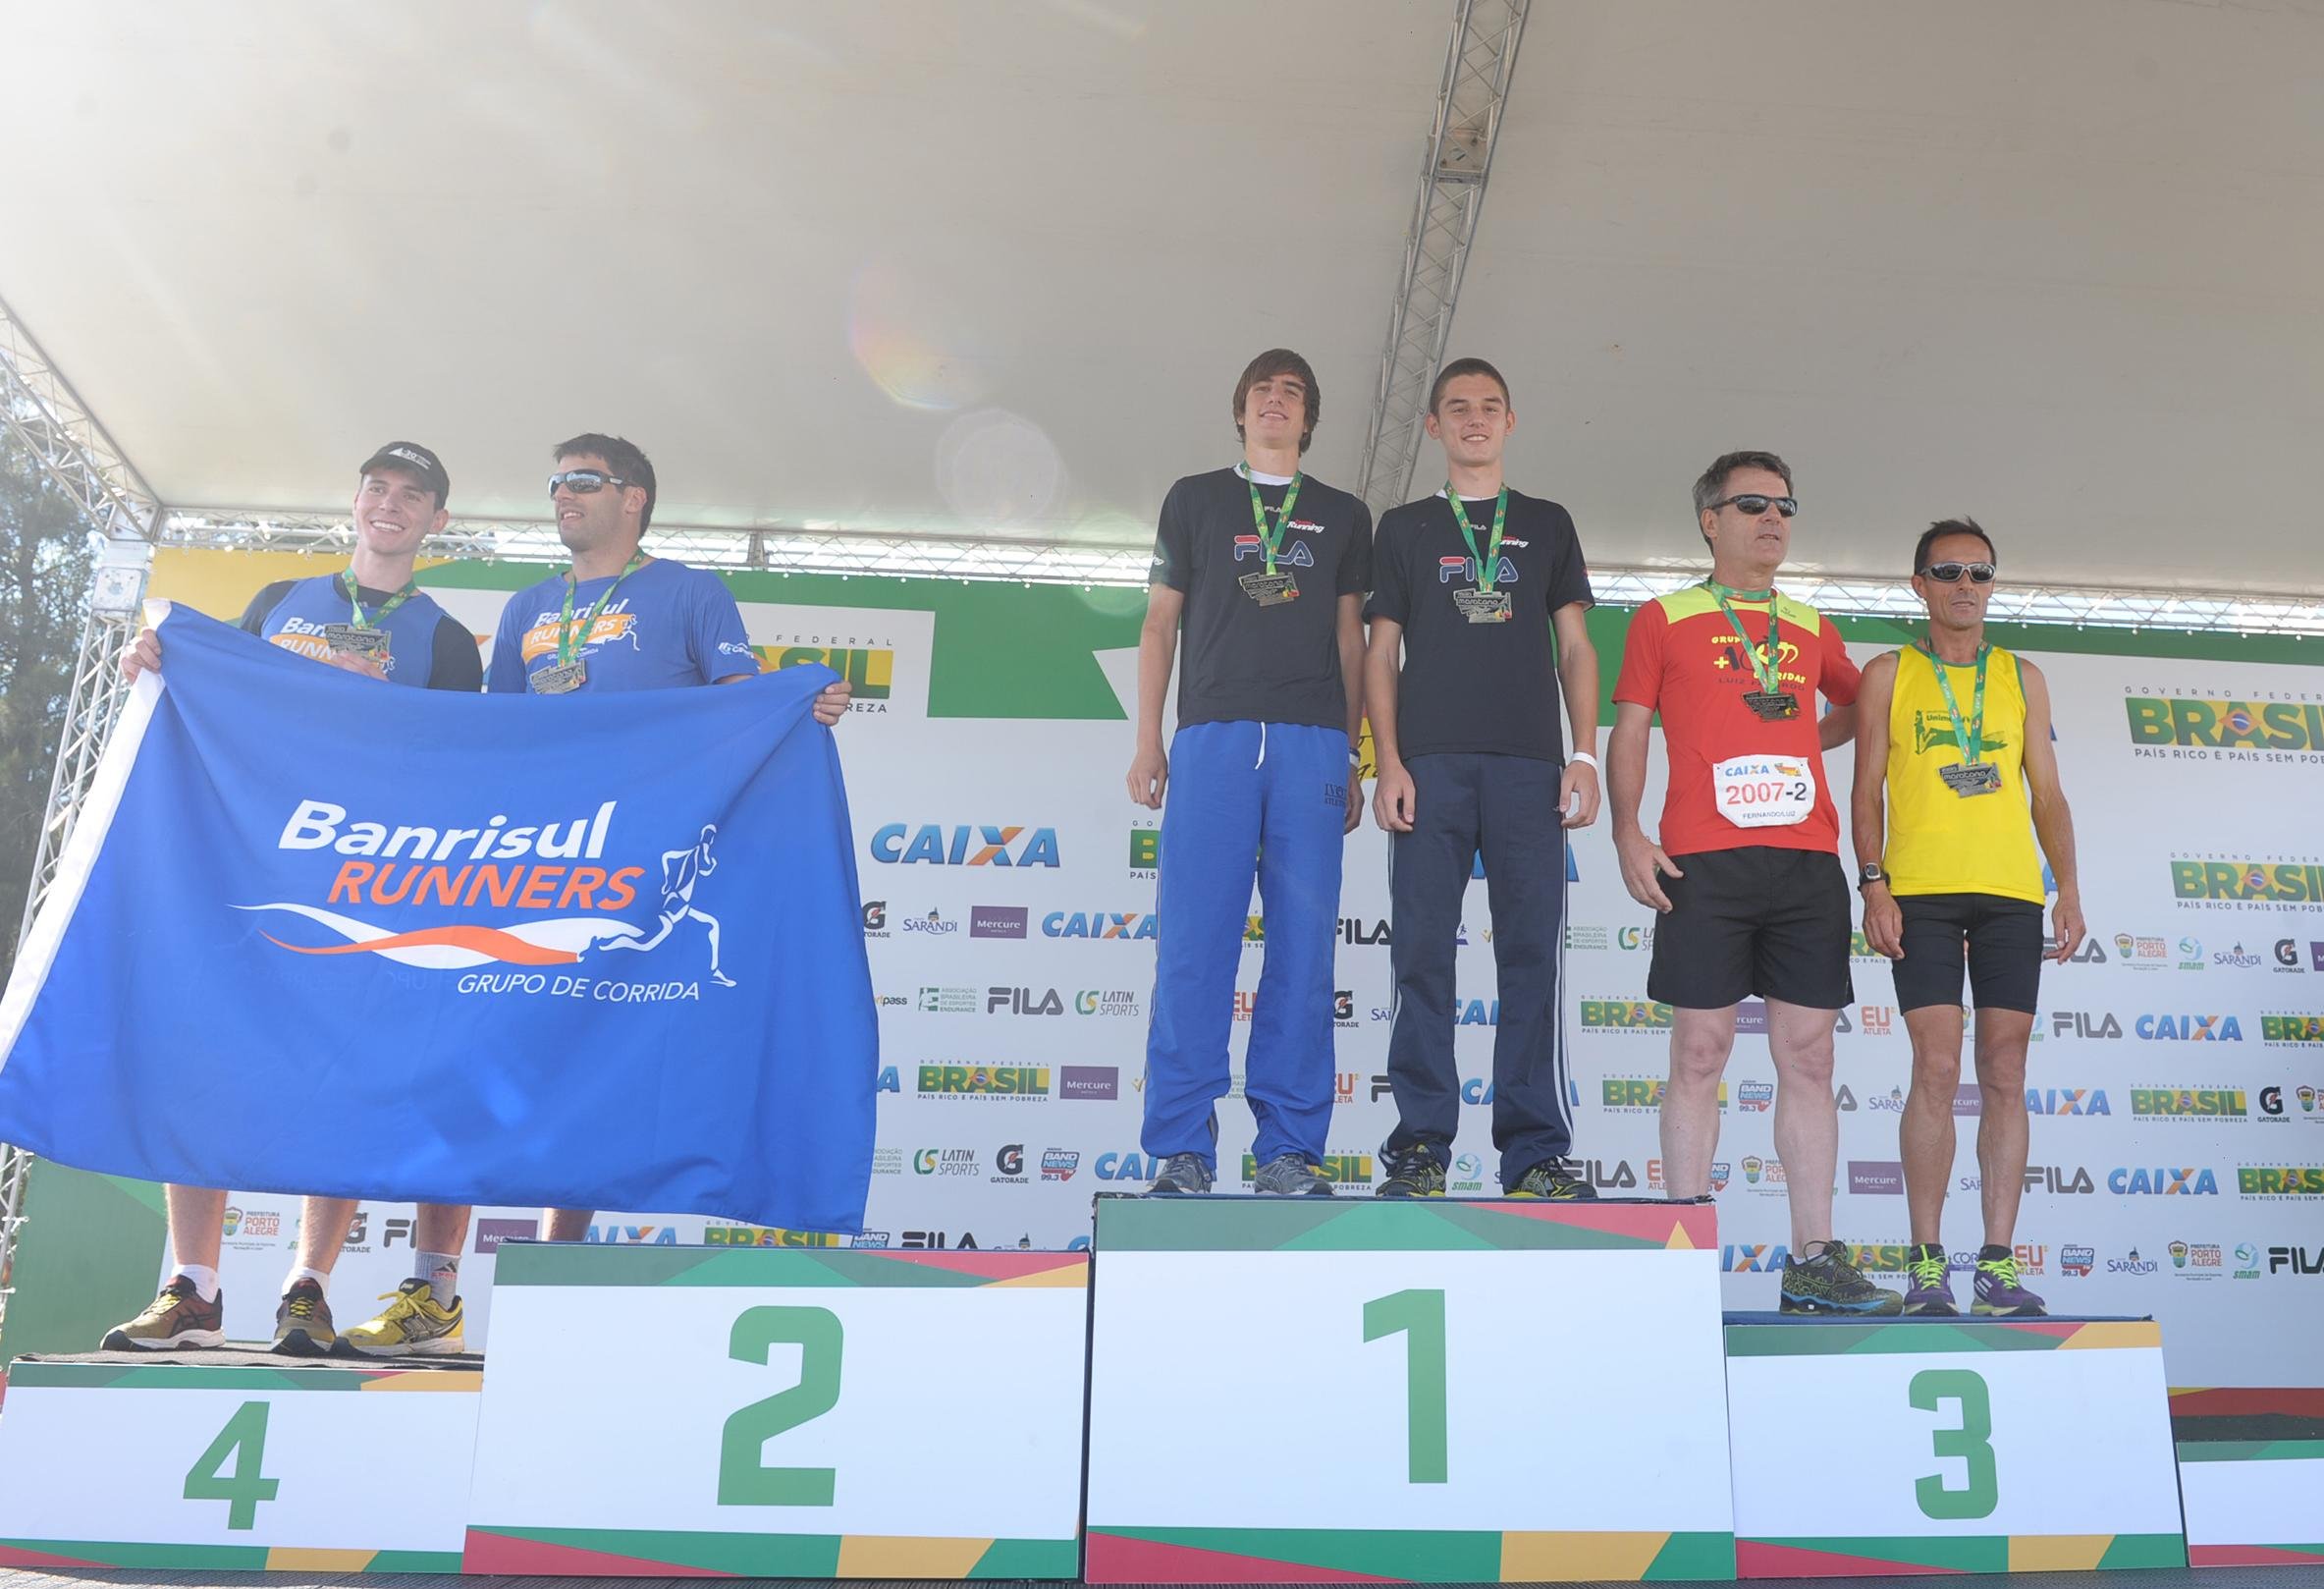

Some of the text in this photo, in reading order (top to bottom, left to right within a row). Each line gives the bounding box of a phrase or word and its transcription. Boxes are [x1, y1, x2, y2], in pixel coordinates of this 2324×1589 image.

[1286, 520, 1325, 533] Running
[533, 598, 629, 629] Bariul
[776, 634, 892, 646] FEDERAL
[2125, 685, 2322, 700] GOVERNO FEDER
[846, 703, 888, 713] REZA
[2126, 697, 2324, 751] BRASI
[2135, 748, 2166, 758] PAÍS
[2173, 749, 2207, 760] RICO
[2229, 751, 2260, 762] PAÍS
[2266, 753, 2294, 763] SEM
[1725, 764, 1769, 777] CAIXA
[1726, 782, 1807, 804] 2007-2
[278, 799, 618, 861] Banrisul
[870, 823, 1061, 868] CAIXA
[326, 861, 646, 910] RUNNERS
[2170, 861, 2324, 903] BRASI
[2177, 901, 2201, 909] PAÍS
[2206, 902, 2232, 910] RICO
[2247, 903, 2271, 911] PAÍS
[2276, 904, 2297, 912] SEM
[977, 919, 1021, 929] Mercure
[1042, 911, 1158, 940] CAIXA
[457, 973, 700, 1003] GRUPO DE CORRIDA
[1102, 990, 1134, 1003] LATIN
[875, 995, 908, 1007] rtpass
[987, 987, 1064, 1015] FILA
[1100, 1004, 1139, 1016] SPORTS
[1581, 1001, 1673, 1028] BRAS
[1861, 1006, 1891, 1027] EU
[2052, 1012, 2123, 1039] FILA
[2135, 1014, 2243, 1041] CAIXA
[2260, 1016, 2324, 1041] BRA
[918, 1066, 1050, 1095] BRASIL
[1066, 1079, 1111, 1090] Mercure
[1602, 1080, 1667, 1106] BRA
[2026, 1088, 2111, 1116] AIXA
[2131, 1089, 2247, 1116] BRASIL
[942, 1149, 975, 1162] LATIN
[1043, 1160, 1077, 1169] NEWS
[1044, 1152, 1078, 1161] BAND
[1094, 1152, 1157, 1180] CAI
[939, 1163, 980, 1177] SPORTS
[1855, 1175, 1897, 1184] Mercure
[2024, 1167, 2094, 1194] FILA
[2107, 1167, 2219, 1195] CAIXA
[2237, 1168, 2324, 1194] BRAS
[1451, 1180, 1483, 1191] smam
[243, 1227, 280, 1235] ALEGRE
[245, 1218, 280, 1227] PORTO
[581, 1226, 676, 1245] AIXA
[1722, 1244, 1788, 1273] IXA
[2063, 1248, 2093, 1257] BAND
[2191, 1258, 2222, 1267] ALEGRE
[2233, 1271, 2260, 1280] smam
[1362, 1288, 1448, 1484] 1
[717, 1305, 844, 1507] 2
[1908, 1369, 1999, 1520] 3
[183, 1401, 281, 1531] 4
